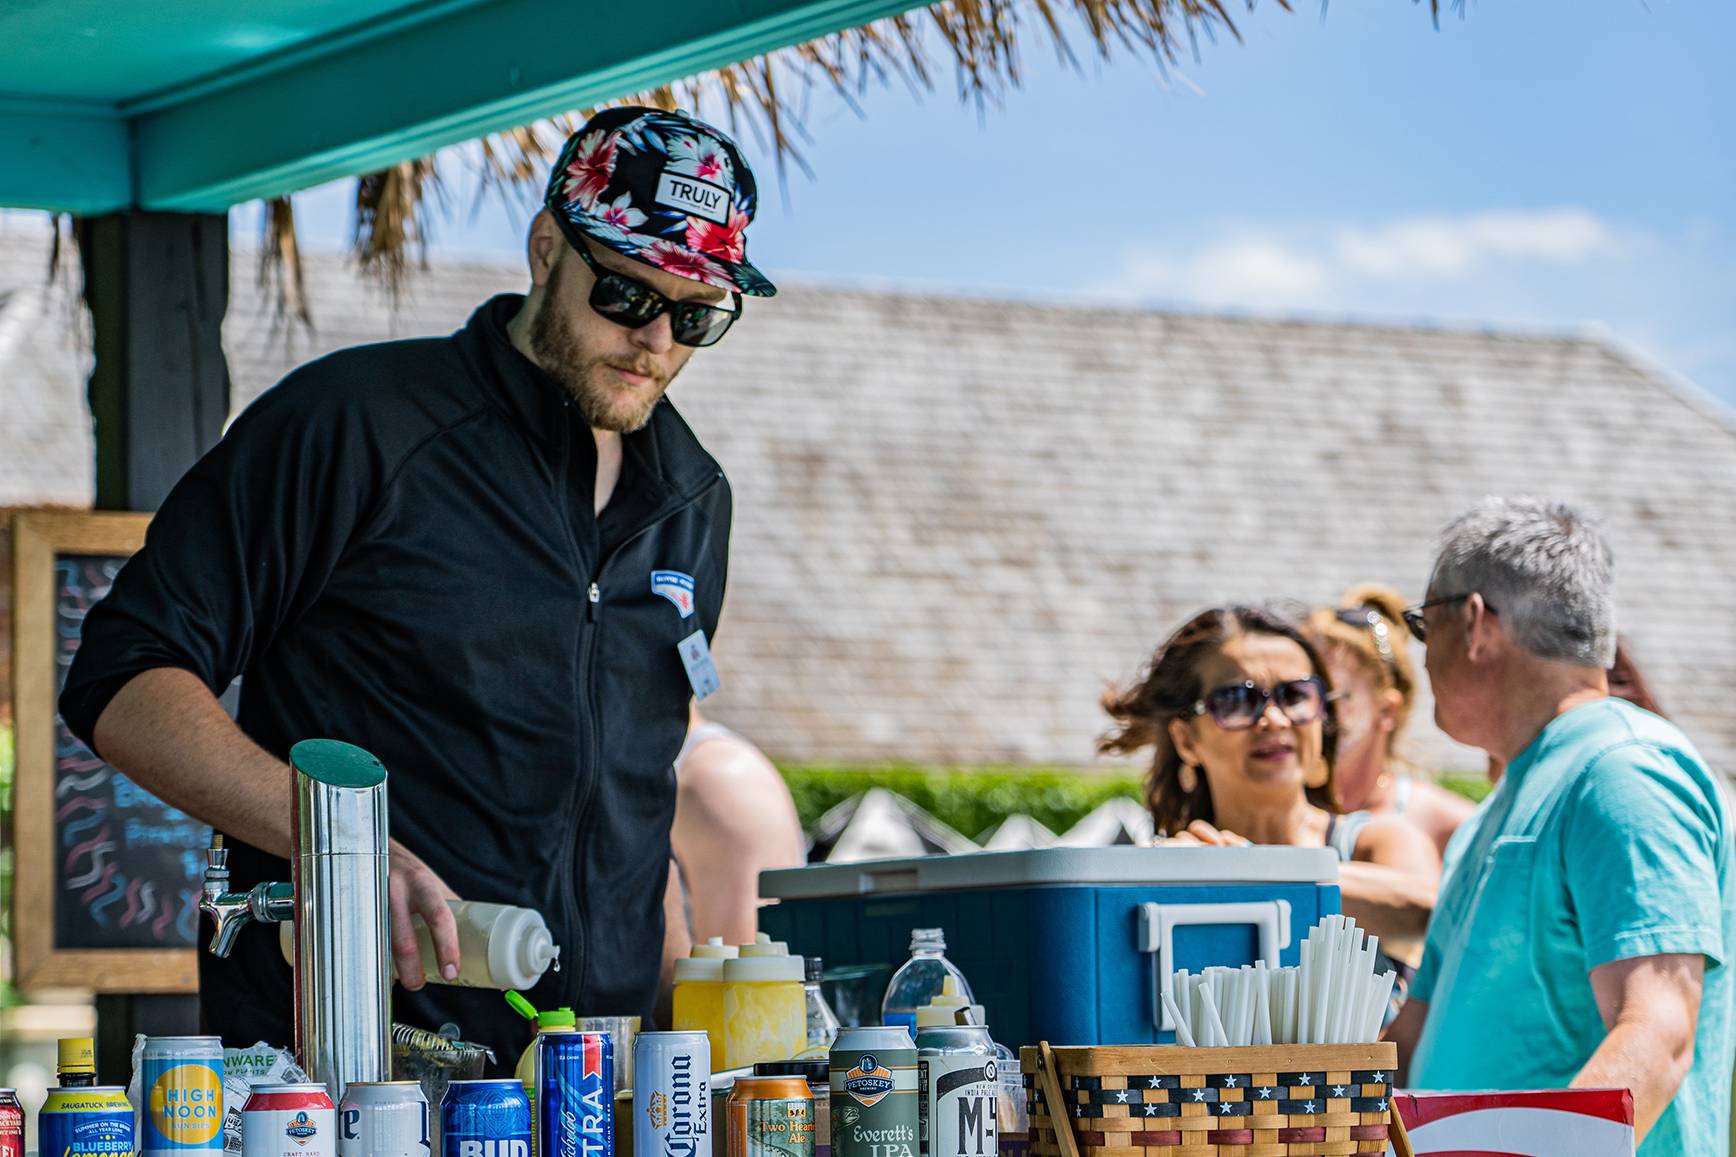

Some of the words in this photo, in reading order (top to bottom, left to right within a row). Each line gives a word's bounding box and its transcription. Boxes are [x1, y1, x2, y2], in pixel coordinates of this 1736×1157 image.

[670, 180, 721, 209] TRULY
[847, 1079, 891, 1089] PETOSKEY
[167, 1088, 215, 1102] HIGH
[163, 1105, 217, 1118] NOON
[664, 1055, 699, 1157] Corona
[693, 1081, 707, 1136] Extra
[560, 1102, 576, 1157] ichelob
[760, 1120, 785, 1132] Two
[789, 1133, 806, 1144] Ale
[853, 1124, 914, 1142] Everett's
[73, 1140, 133, 1152] BLUEBERRY
[869, 1144, 914, 1157] IPA
